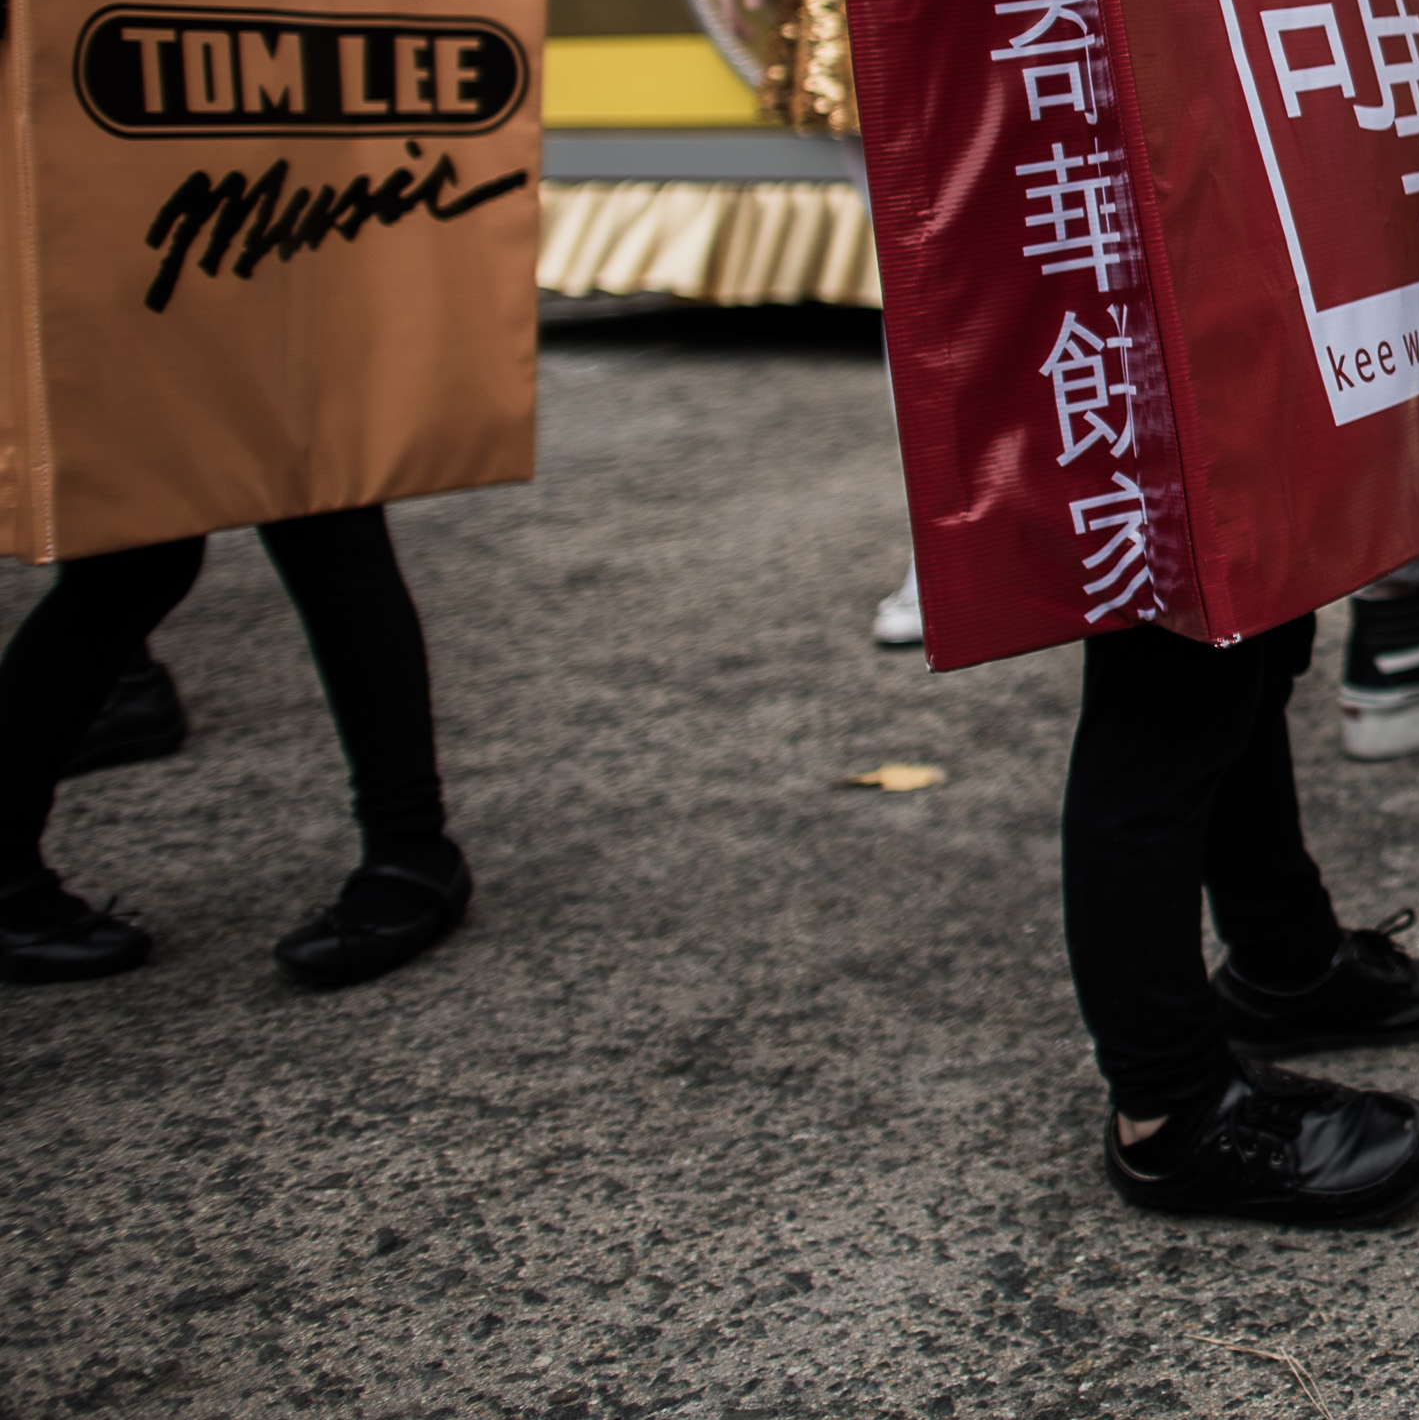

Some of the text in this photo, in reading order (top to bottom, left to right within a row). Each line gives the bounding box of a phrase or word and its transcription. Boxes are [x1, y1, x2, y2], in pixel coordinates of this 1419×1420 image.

[121, 27, 481, 115] TOM LEE
[145, 139, 527, 314] Music
[1326, 340, 1397, 392] kee
